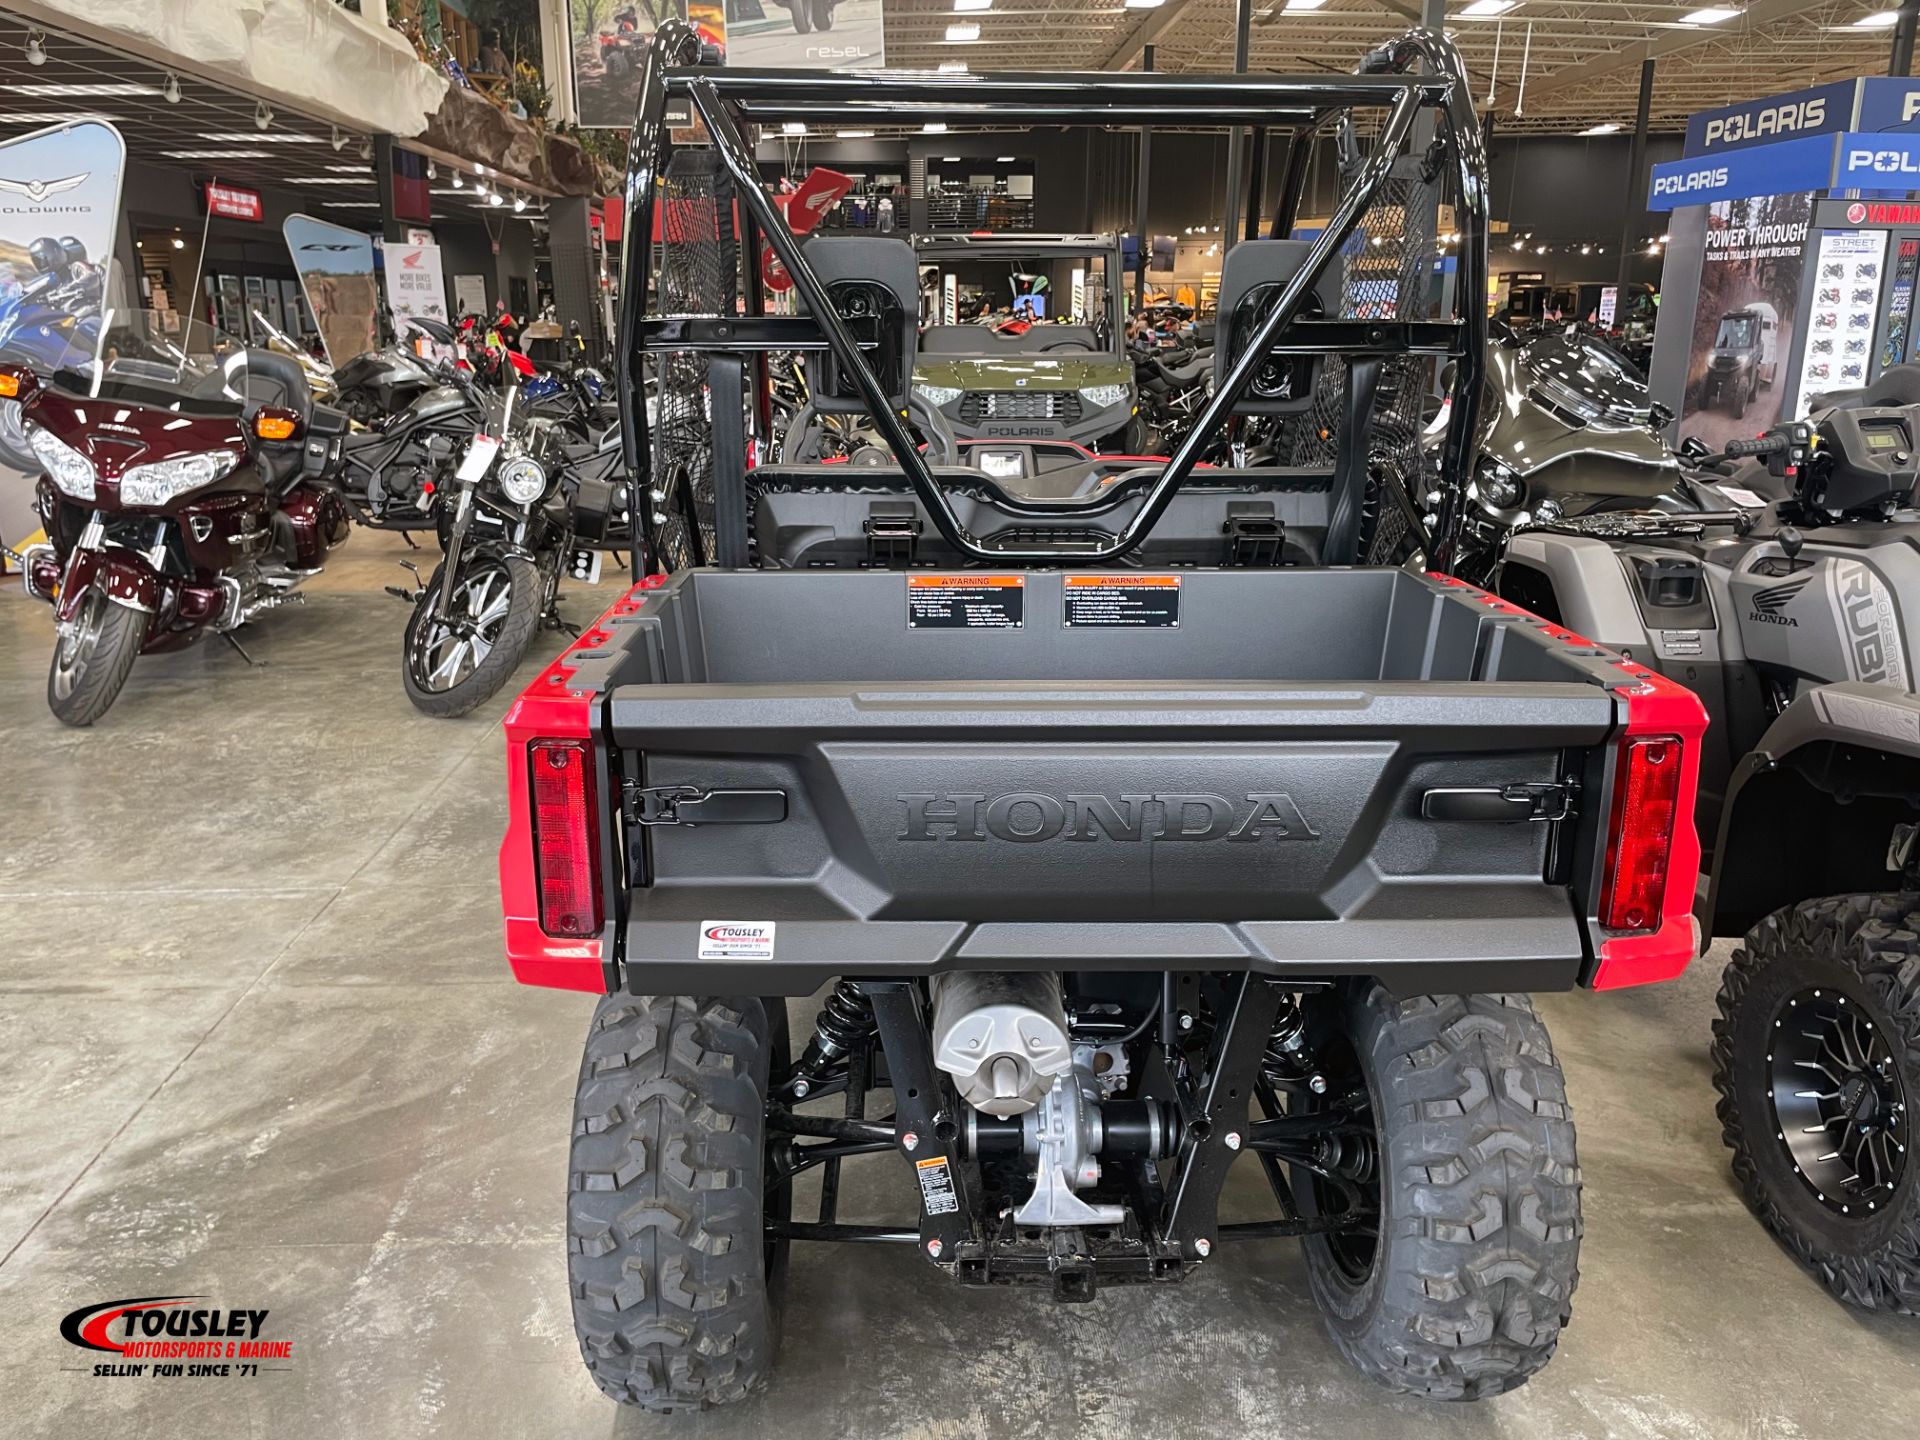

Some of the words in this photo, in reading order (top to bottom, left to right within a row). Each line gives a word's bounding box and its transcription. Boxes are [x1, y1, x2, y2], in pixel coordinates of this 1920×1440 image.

[1705, 98, 1826, 147] POLARIS
[1848, 150, 1920, 172] POL
[1654, 168, 1728, 196] POLARIS
[0, 206, 91, 214] OLDWING
[1705, 228, 1746, 248] POWER
[1748, 222, 1808, 246] THROUGH
[1706, 251, 1723, 261] TASKS
[1723, 251, 1729, 260] &
[1729, 249, 1750, 260] TRAILS
[1758, 248, 1771, 258] ANY
[1771, 246, 1801, 257] WEATHER
[400, 273, 414, 281] MORE
[400, 282, 415, 290] MORE
[988, 427, 1054, 436] POLARIS
[950, 577, 990, 585] WARNING
[1108, 577, 1145, 585] WARNING
[1748, 612, 1799, 627] HONDA
[896, 791, 1321, 843] HONDA
[722, 928, 765, 937] TOUSLEY
